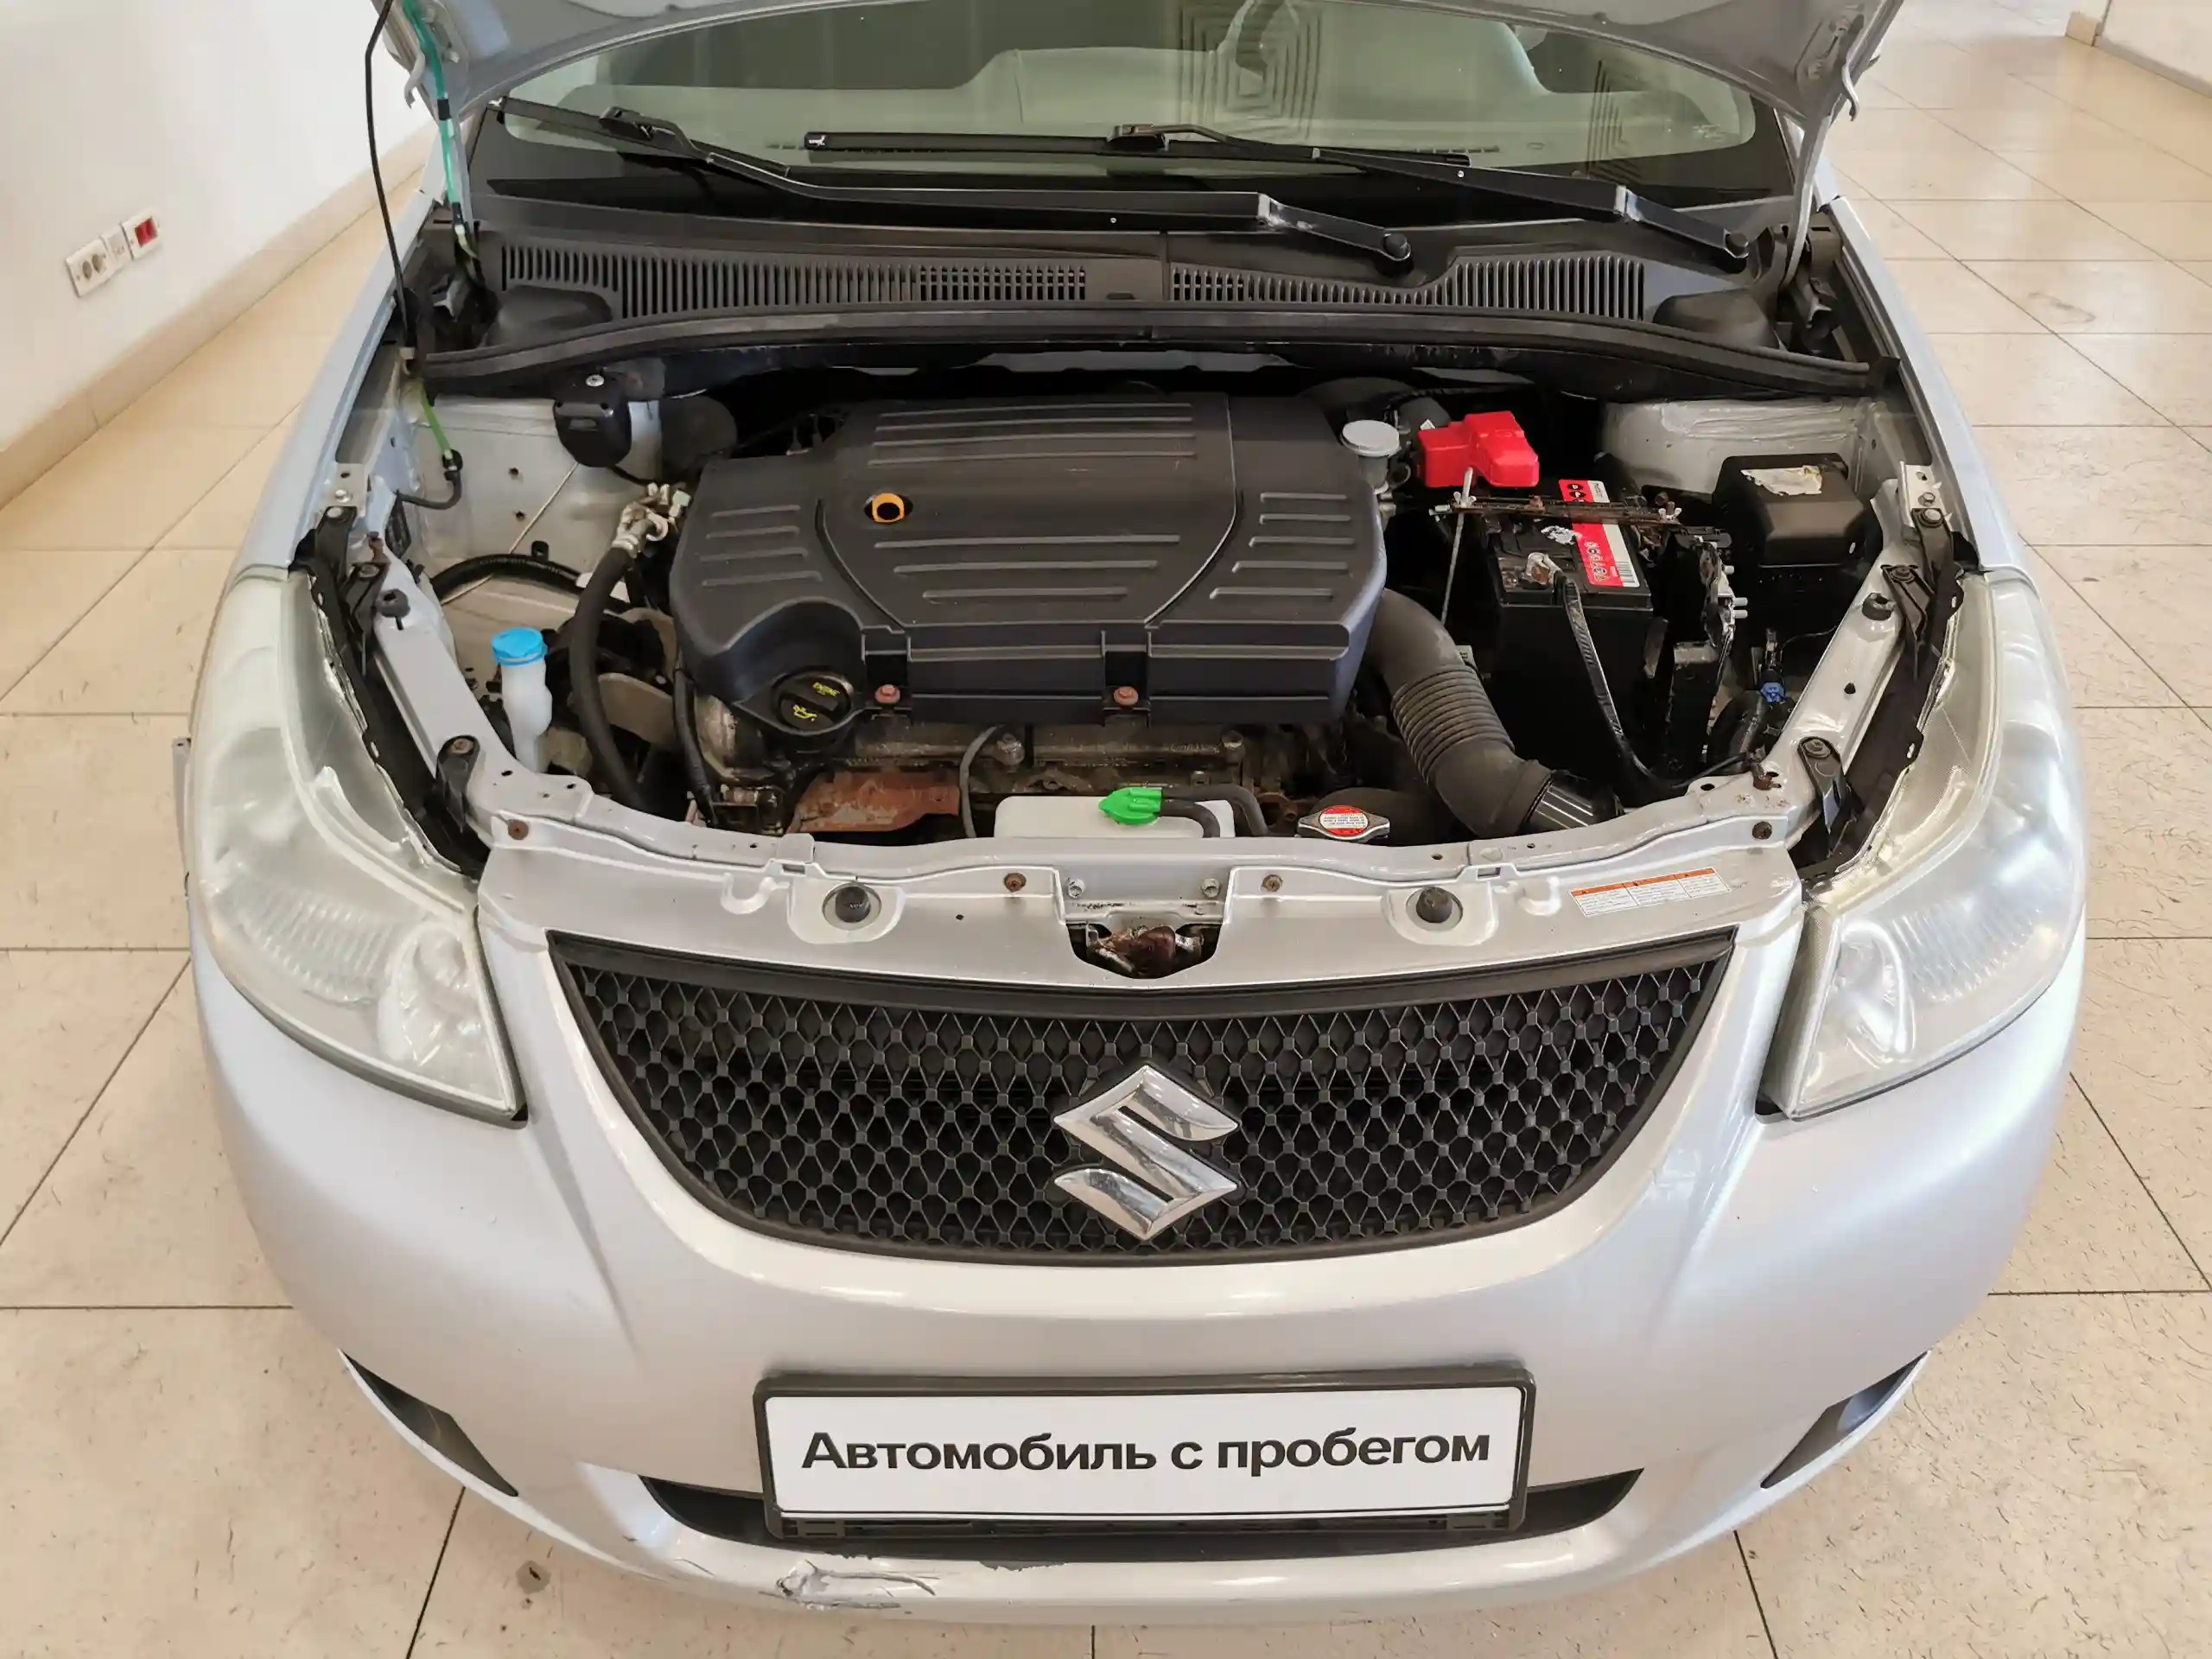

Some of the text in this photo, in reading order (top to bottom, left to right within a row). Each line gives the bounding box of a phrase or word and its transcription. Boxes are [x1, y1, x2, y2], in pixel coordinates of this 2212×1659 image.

[801, 1427, 1490, 1478] Автомобиль с пробегом
